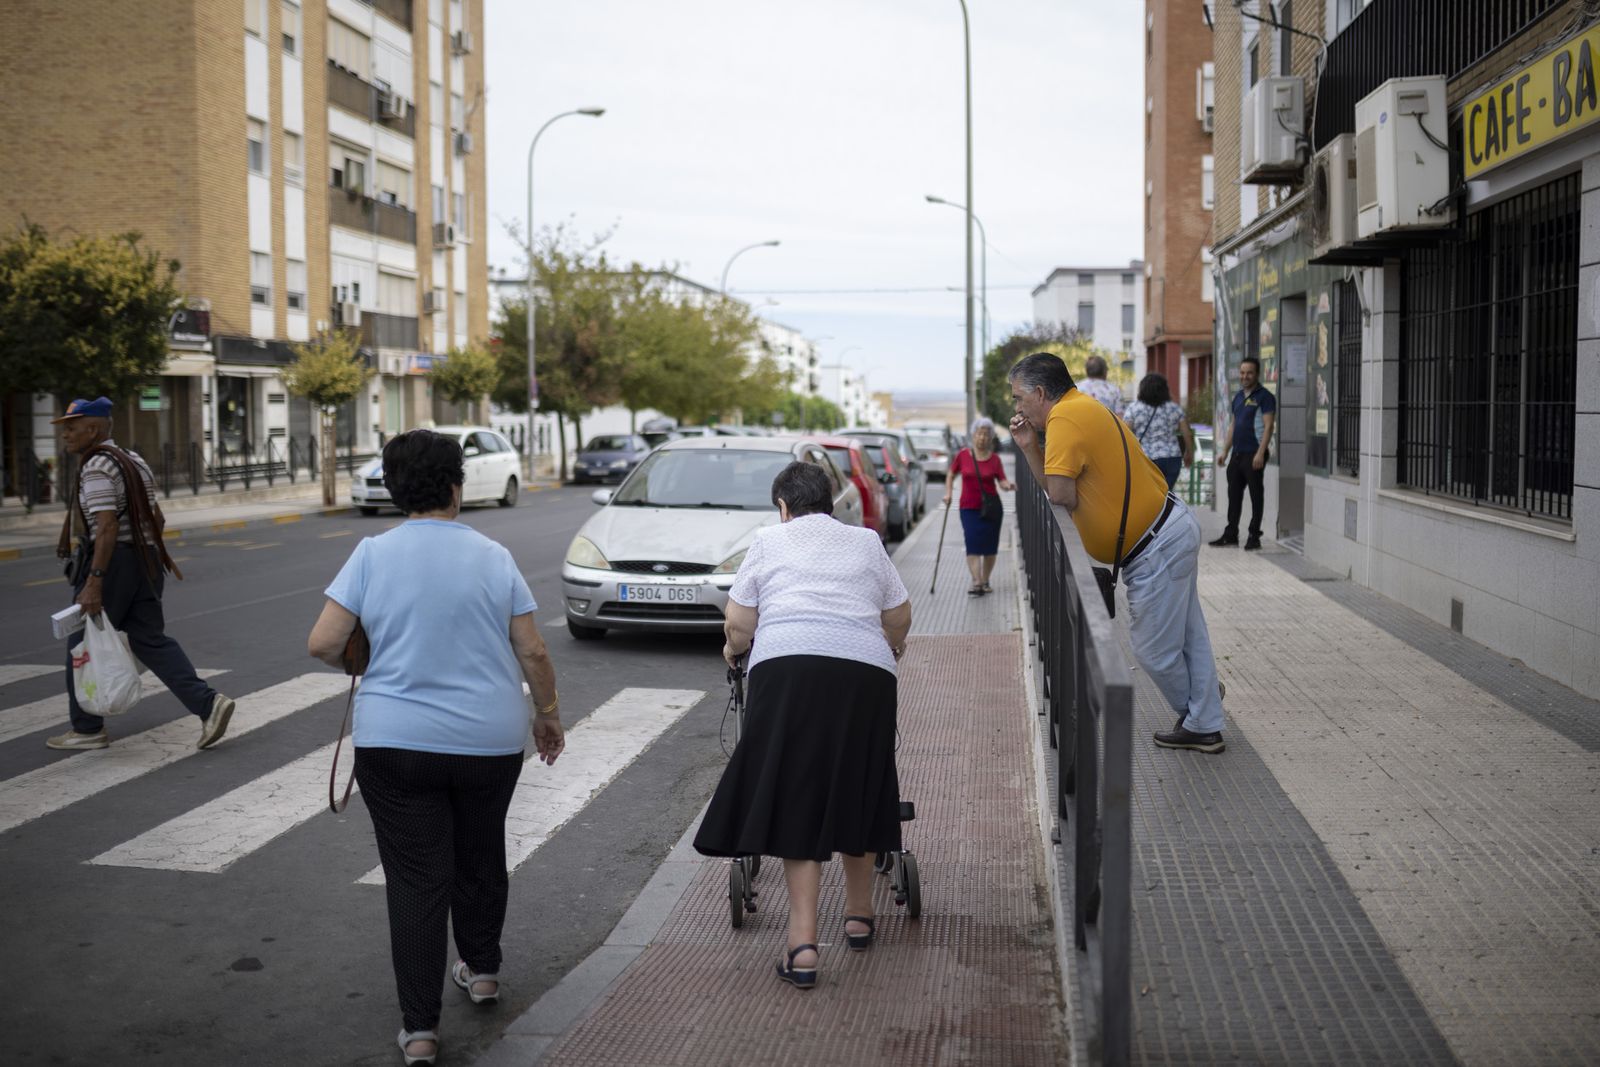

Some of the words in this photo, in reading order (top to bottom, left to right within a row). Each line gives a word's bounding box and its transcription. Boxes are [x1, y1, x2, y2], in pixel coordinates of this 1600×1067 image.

[1469, 73, 1531, 166] CAFE
[628, 587, 662, 600] 5904
[668, 588, 694, 601] DGS
